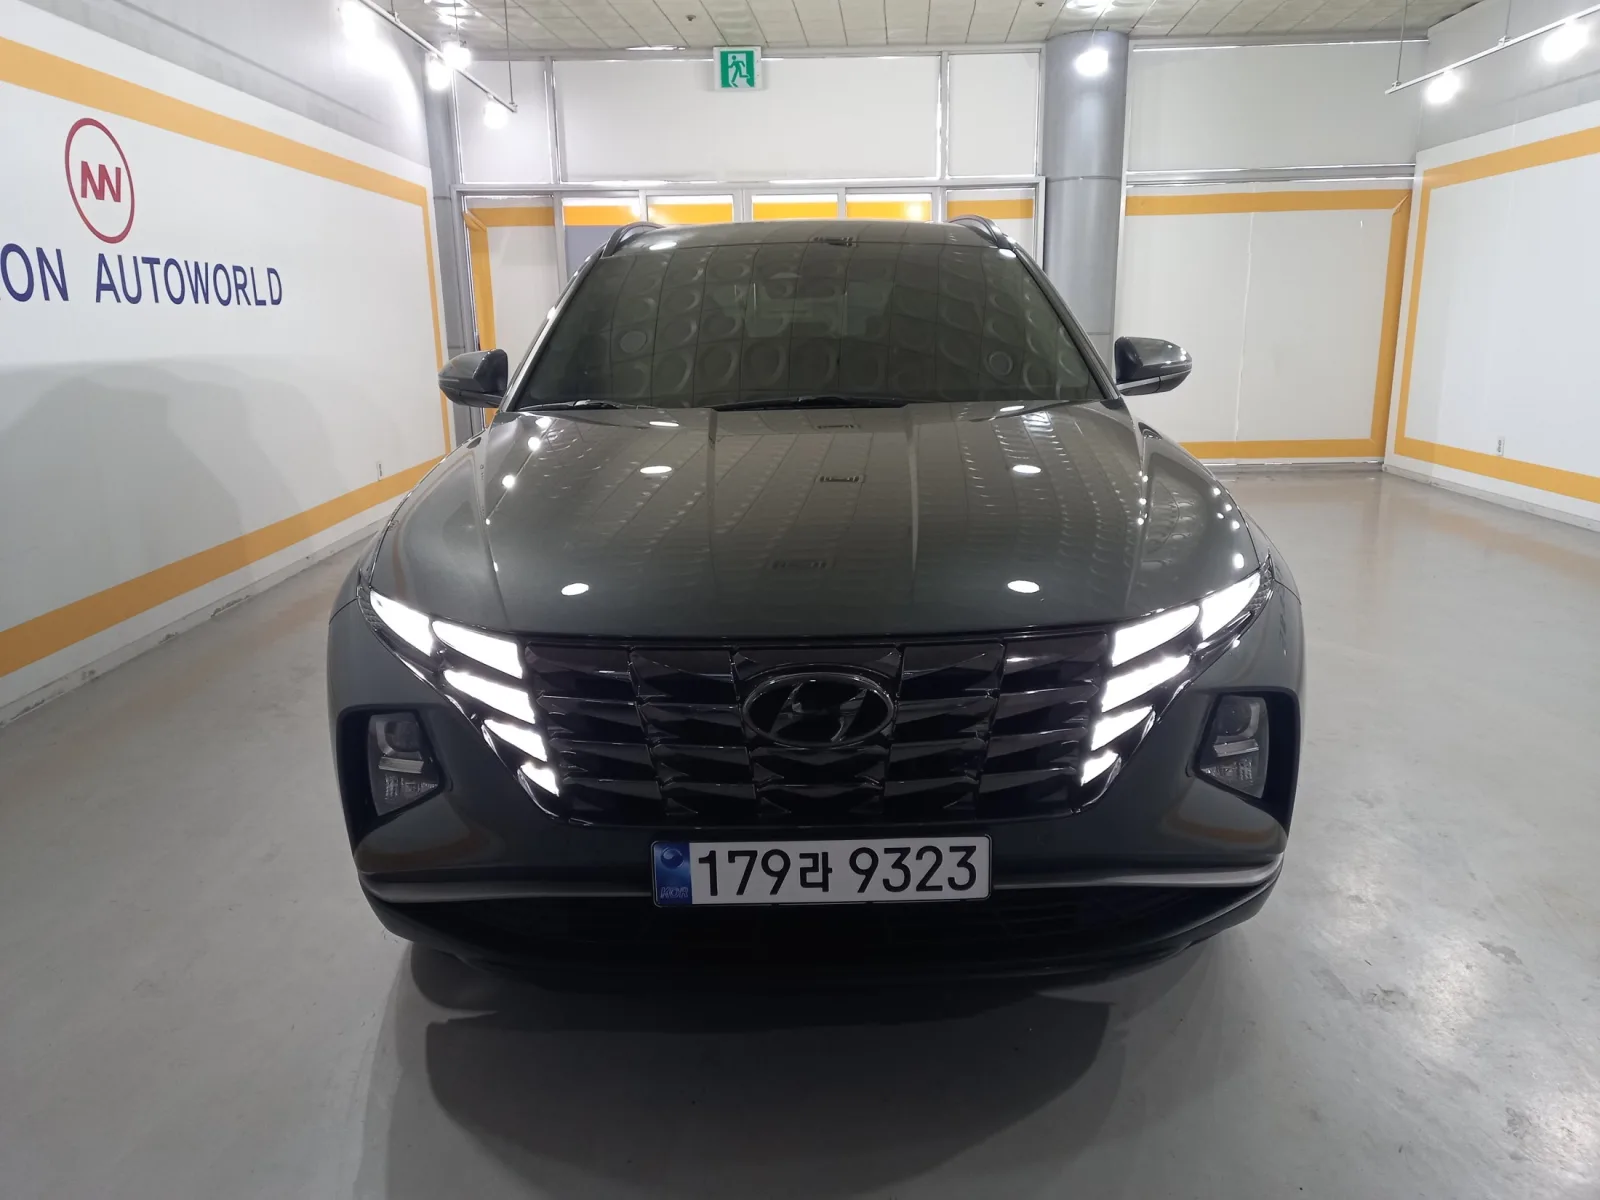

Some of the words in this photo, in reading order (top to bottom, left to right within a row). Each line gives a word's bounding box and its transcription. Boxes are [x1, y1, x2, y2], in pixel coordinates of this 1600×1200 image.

[95, 253, 283, 306] AUTOWORLD
[660, 886, 689, 899] KOR
[698, 848, 833, 897] 179라
[848, 845, 978, 894] 9323
